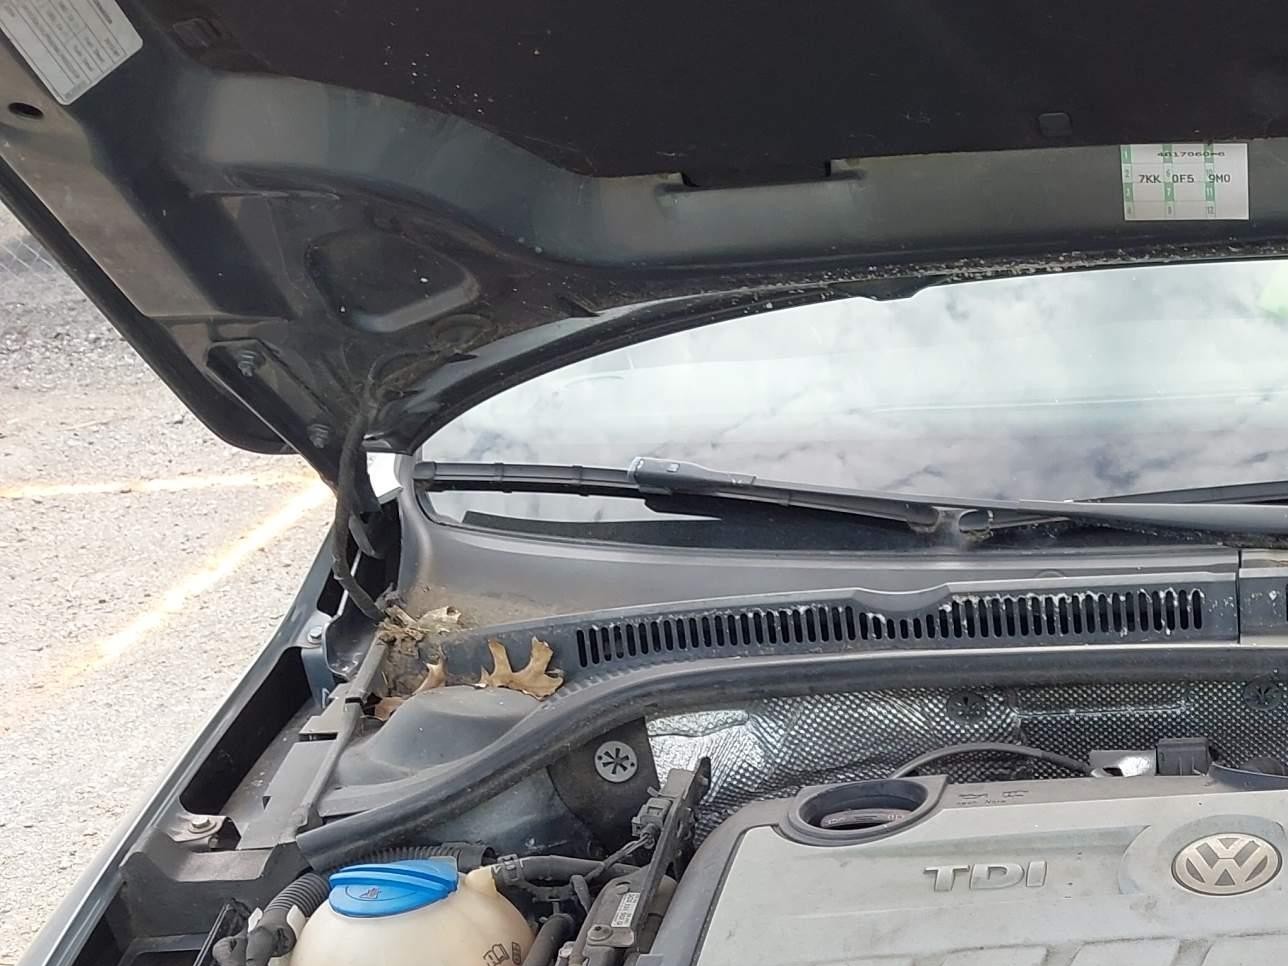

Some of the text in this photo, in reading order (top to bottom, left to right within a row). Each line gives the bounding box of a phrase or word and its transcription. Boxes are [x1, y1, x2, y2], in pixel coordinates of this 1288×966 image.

[1138, 174, 1162, 184] 7KK
[1208, 174, 1231, 184] 9M0
[924, 860, 1047, 892] TDI
